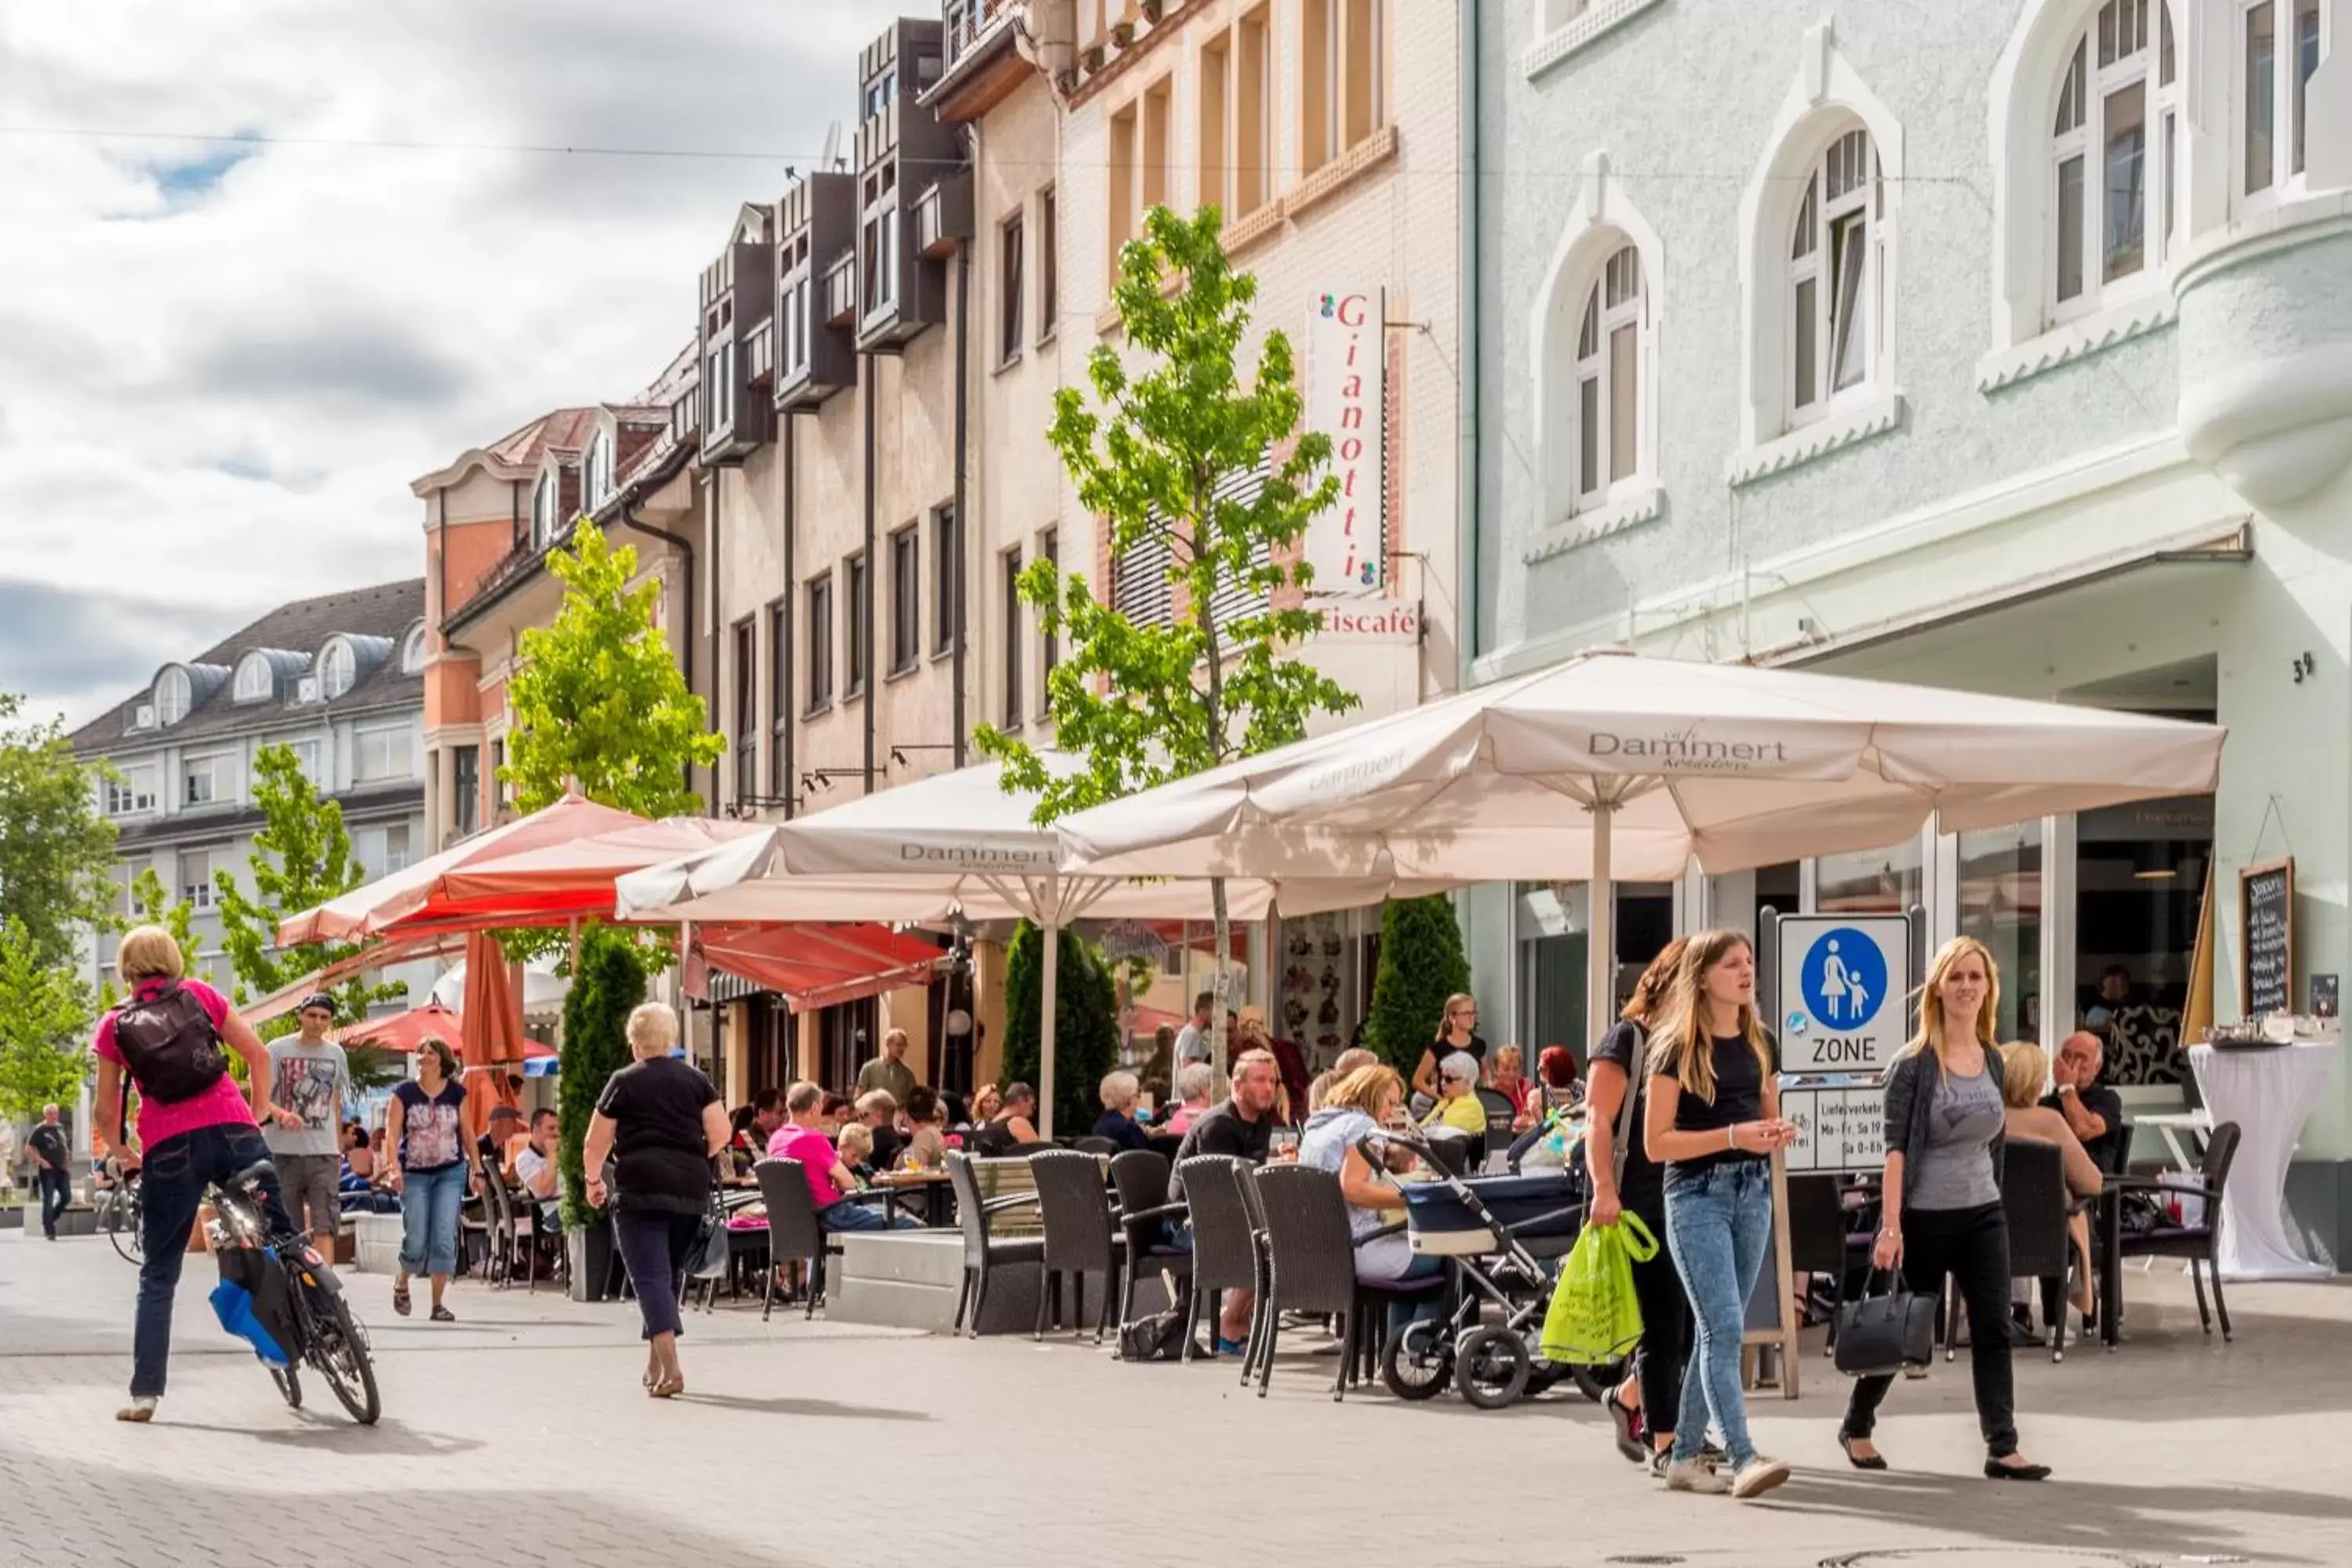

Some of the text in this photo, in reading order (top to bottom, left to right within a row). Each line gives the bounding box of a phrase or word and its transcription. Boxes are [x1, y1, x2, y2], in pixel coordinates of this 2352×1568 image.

[1337, 294, 1367, 577] Gianotti
[1588, 732, 1788, 762] Dammert
[901, 843, 1058, 864] Dammert
[1812, 1036, 1877, 1063] ZONE
